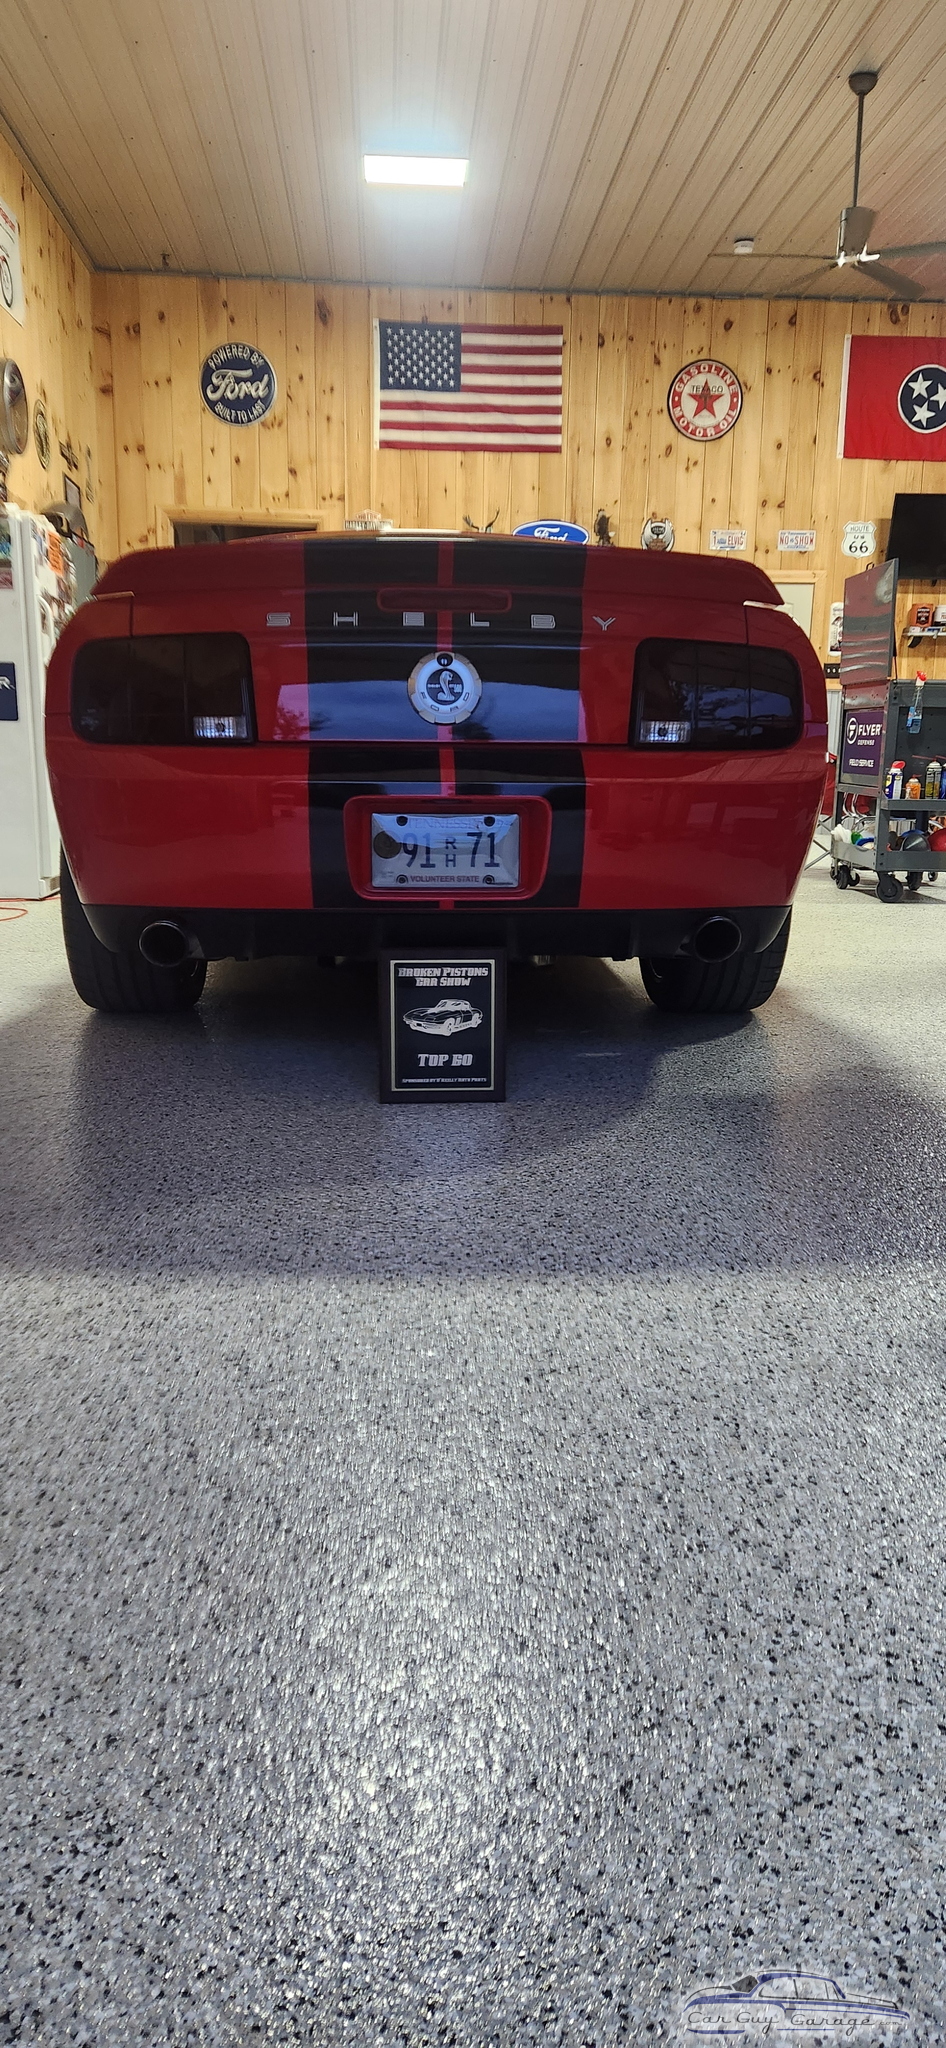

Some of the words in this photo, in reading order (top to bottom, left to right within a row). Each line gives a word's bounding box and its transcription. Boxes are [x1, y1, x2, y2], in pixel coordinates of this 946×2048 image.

[208, 344, 251, 370] POWERED
[250, 352, 265, 368] BY
[206, 368, 269, 401] Ford
[675, 363, 737, 393] GASOLINE
[214, 401, 236, 422] BUILT
[237, 410, 248, 423] TO
[247, 399, 266, 421] LAST
[673, 406, 716, 437] MOTOR
[719, 409, 737, 429] OIL
[727, 535, 745, 546] ELVIS
[779, 535, 790, 545] NO
[794, 536, 815, 546] SHOW
[848, 540, 869, 553] 66
[858, 724, 882, 736] FLYER
[402, 832, 436, 868] 91
[466, 831, 500, 868] 71
[410, 875, 454, 883] VOLUNTEER
[456, 875, 480, 883] STATE
[439, 977, 472, 987] SHOW
[418, 1053, 449, 1067] TOP
